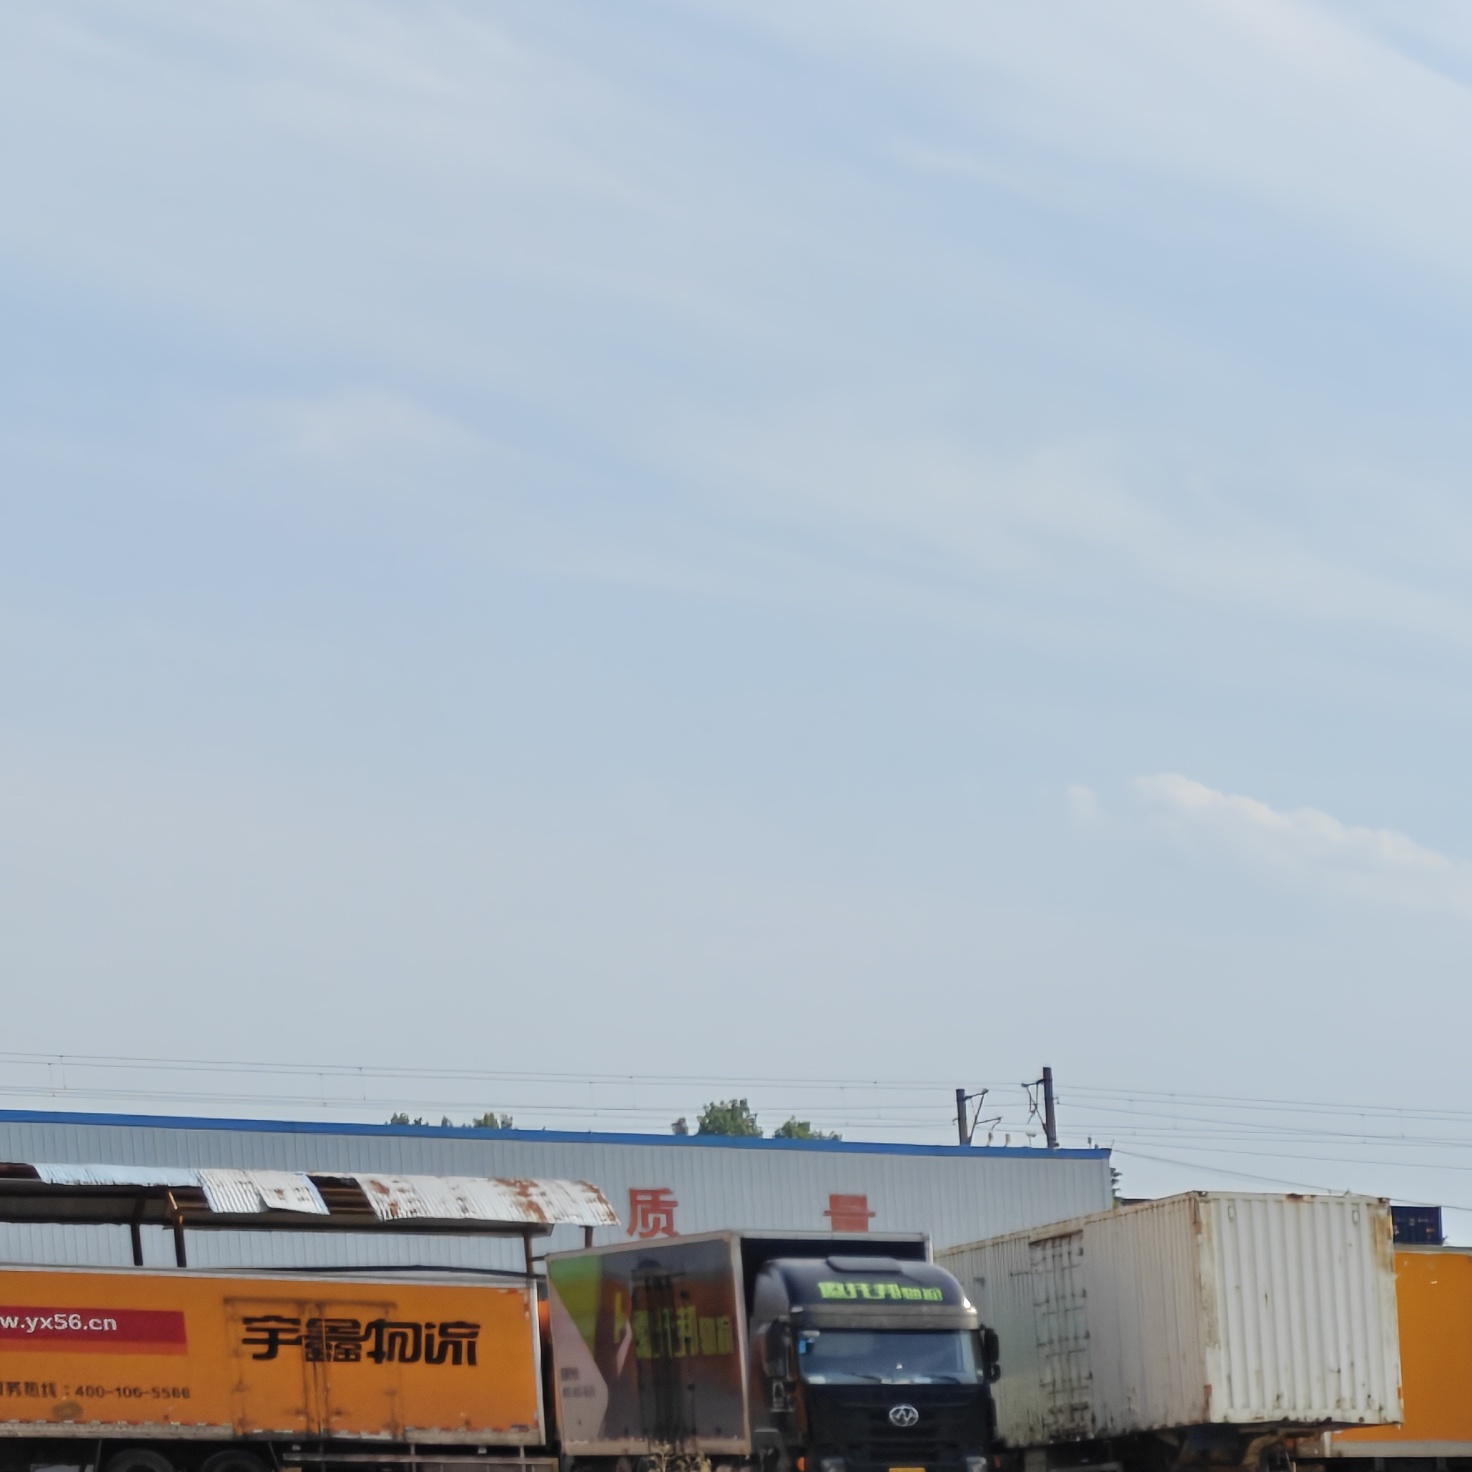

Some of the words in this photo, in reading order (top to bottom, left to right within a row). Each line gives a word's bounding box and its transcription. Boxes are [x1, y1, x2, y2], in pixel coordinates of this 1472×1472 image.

[627, 1187, 680, 1238] 质
[242, 1315, 481, 1366] 宇鑫物流
